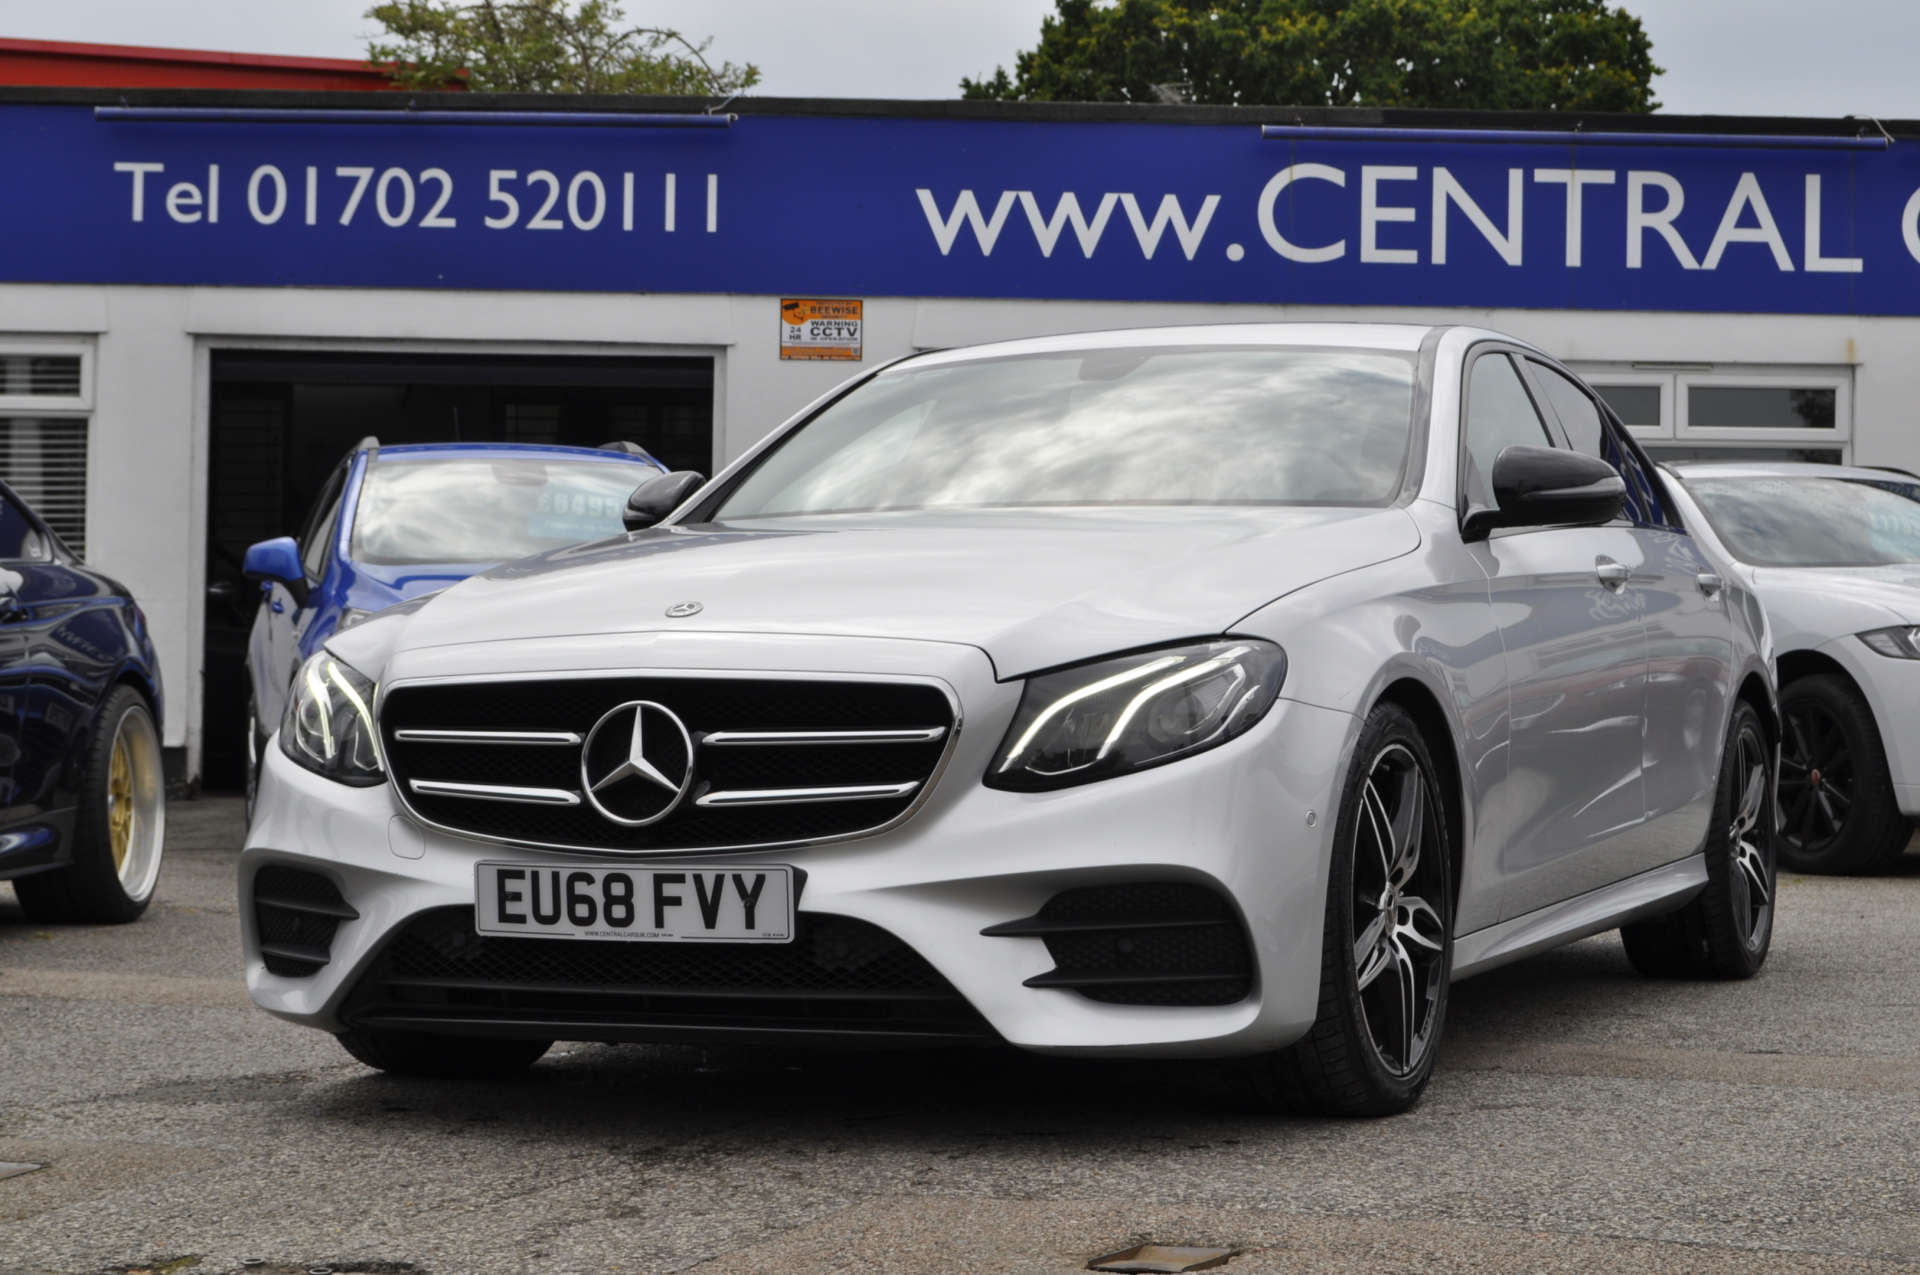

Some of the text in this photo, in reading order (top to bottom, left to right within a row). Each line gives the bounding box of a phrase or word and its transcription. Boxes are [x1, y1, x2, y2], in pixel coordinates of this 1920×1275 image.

[114, 162, 718, 233] Tel 01702 520111
[810, 306, 858, 314] BEEWISE
[810, 327, 858, 337] CCTV
[497, 869, 765, 930] EU68 FVY
